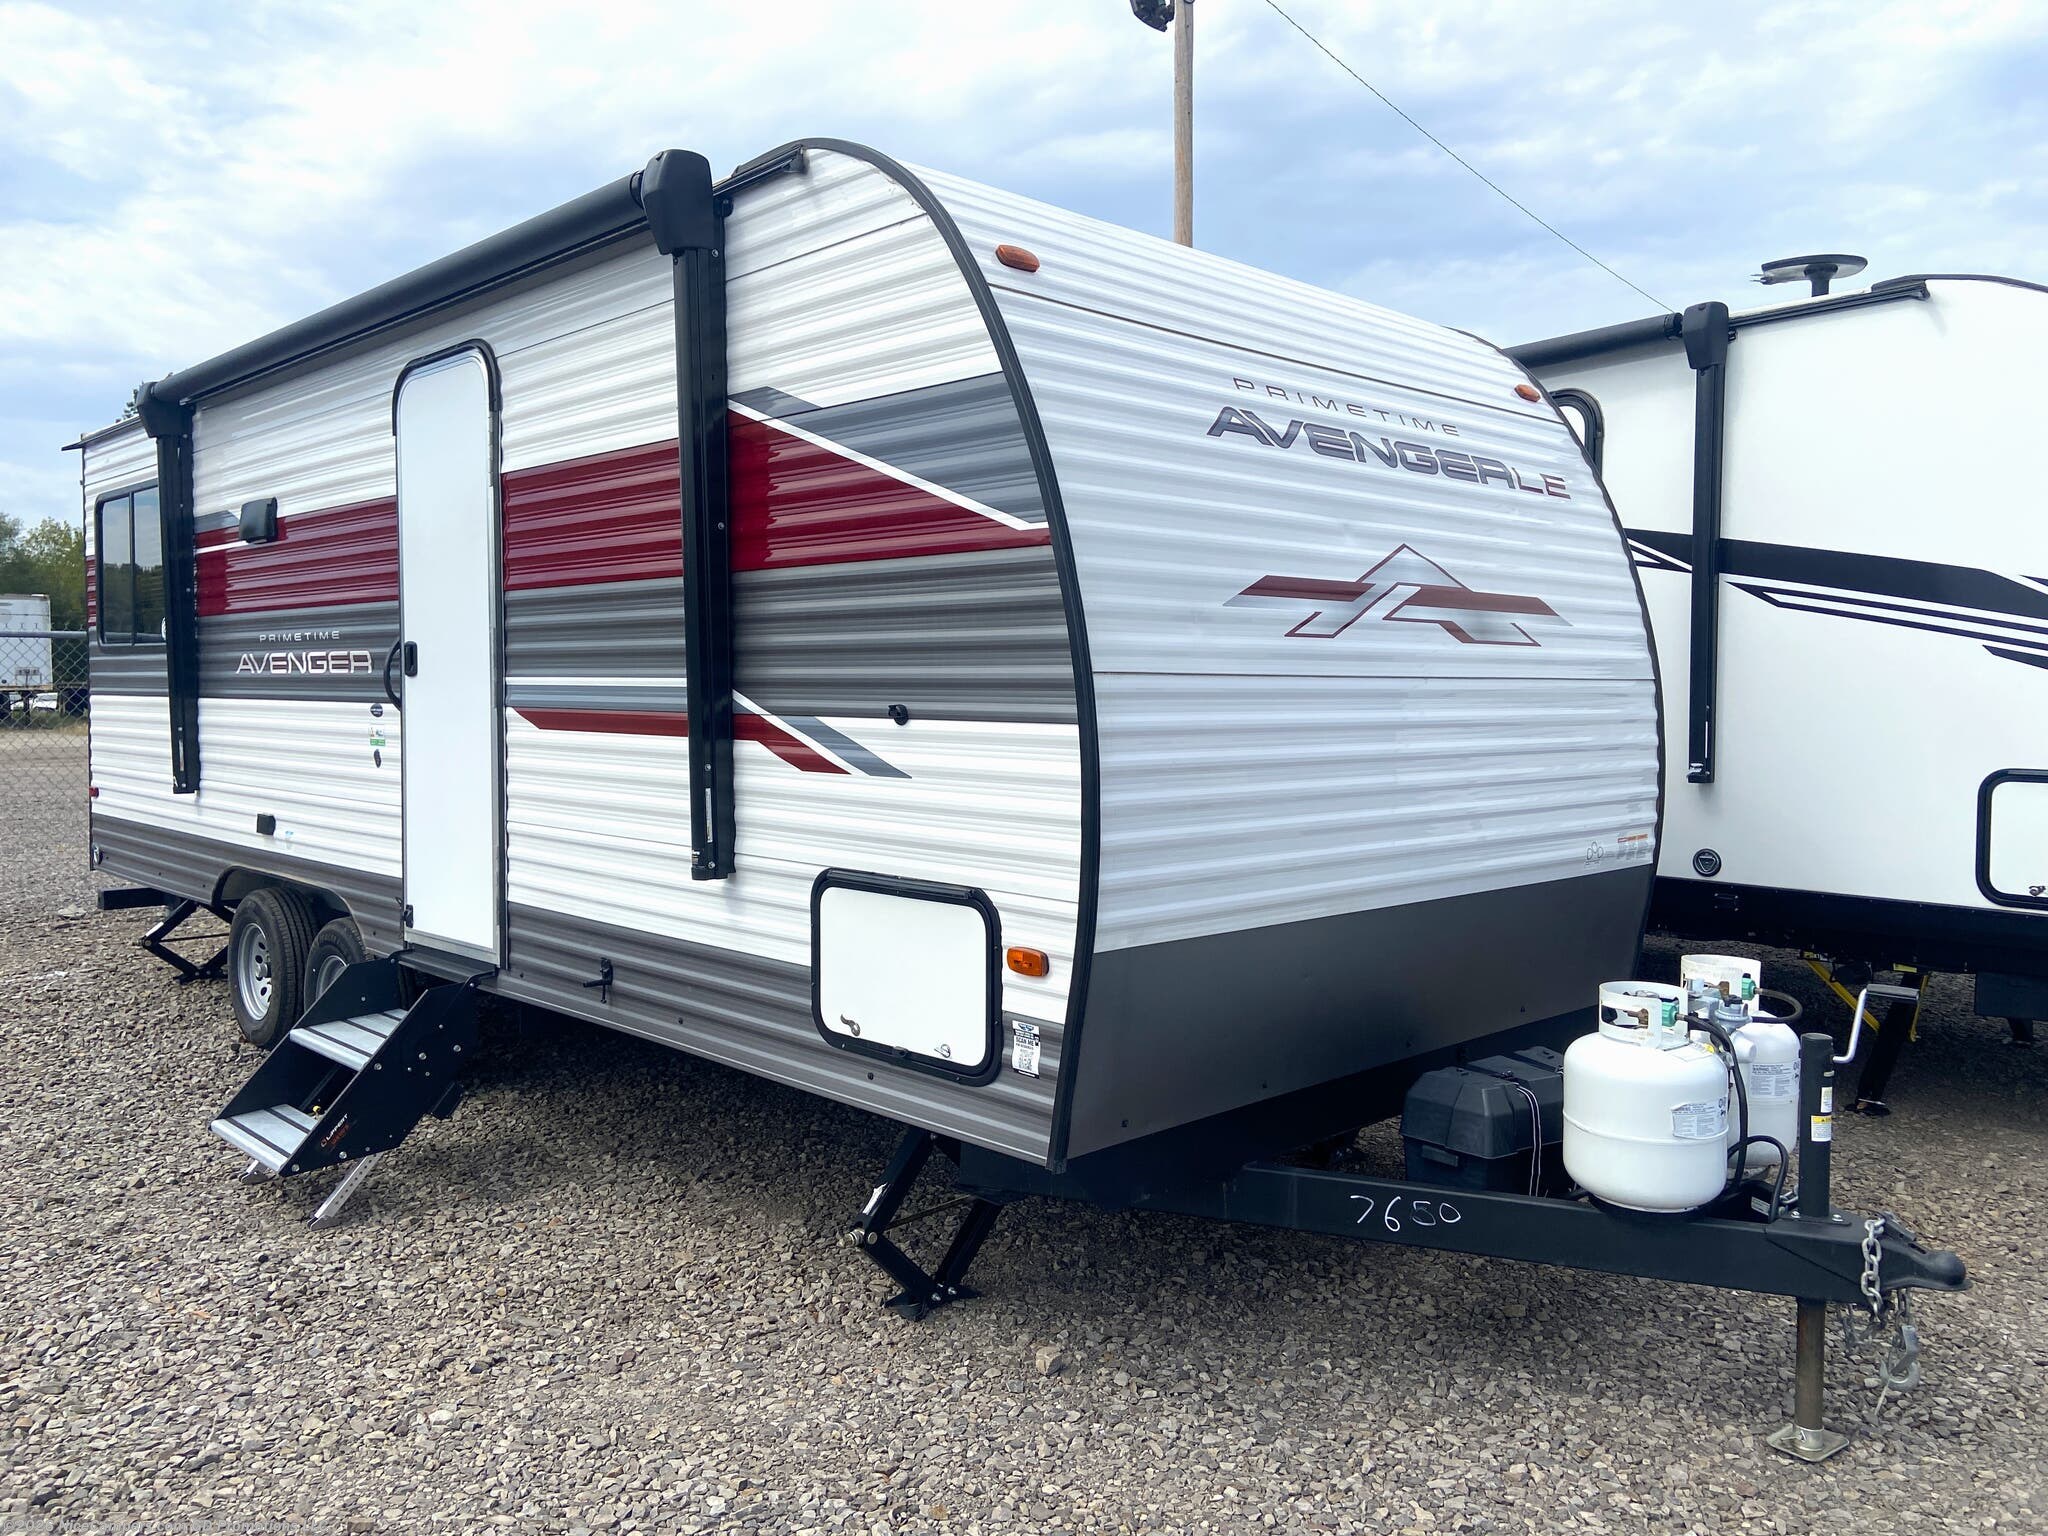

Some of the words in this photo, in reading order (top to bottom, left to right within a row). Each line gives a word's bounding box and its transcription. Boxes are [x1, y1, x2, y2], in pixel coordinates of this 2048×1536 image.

[1233, 377, 1460, 437] PRIMETIME
[1206, 406, 1516, 489] AVENGER
[259, 630, 340, 643] PRIMETIME
[235, 650, 373, 674] AVENGER
[1350, 1195, 1461, 1232] 7650
